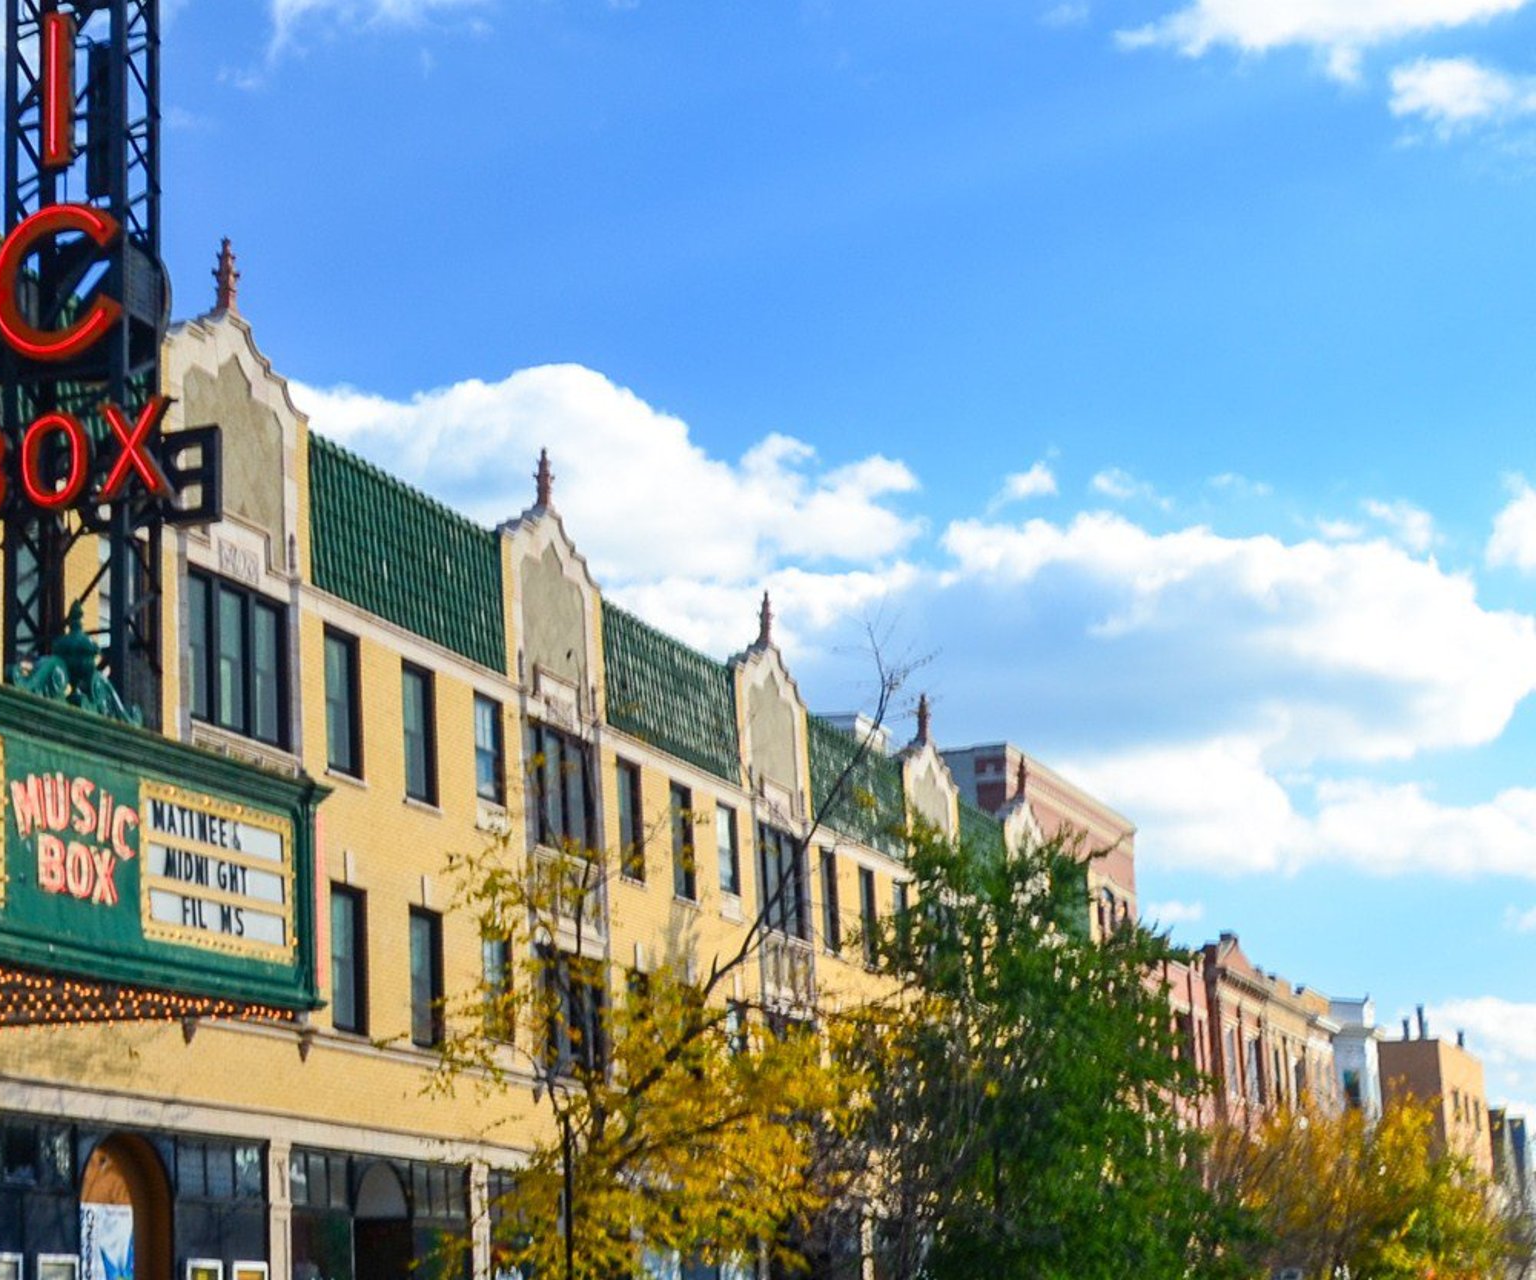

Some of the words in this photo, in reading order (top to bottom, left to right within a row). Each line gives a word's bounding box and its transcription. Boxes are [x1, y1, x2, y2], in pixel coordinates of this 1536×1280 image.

[10, 771, 140, 861] MUSIC
[151, 799, 227, 847] MATINEE
[37, 832, 118, 906] BOX
